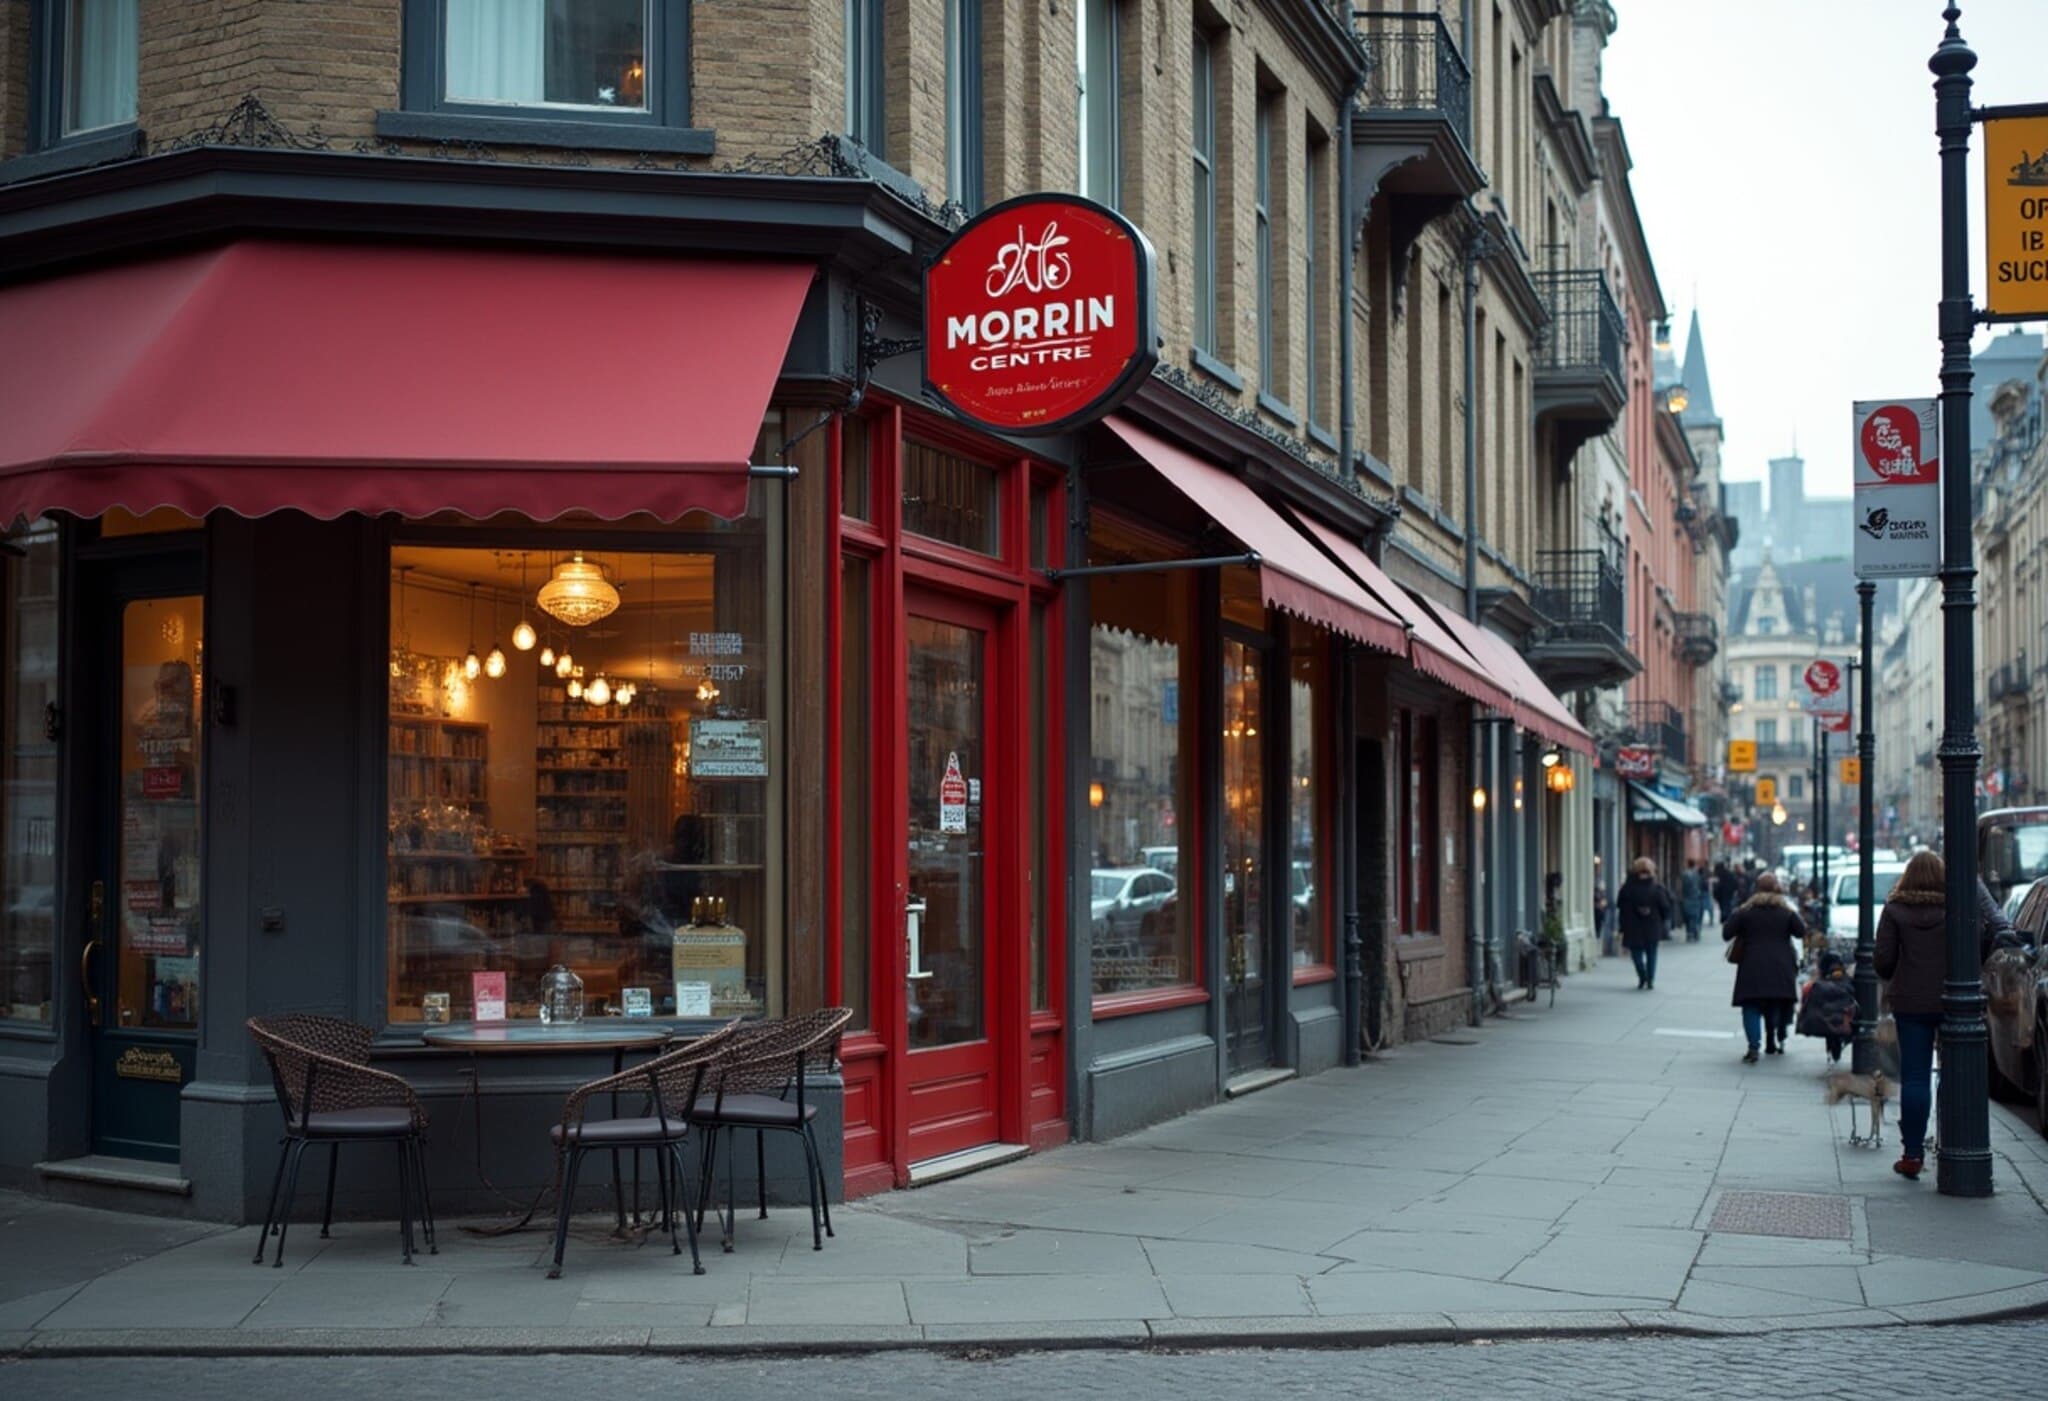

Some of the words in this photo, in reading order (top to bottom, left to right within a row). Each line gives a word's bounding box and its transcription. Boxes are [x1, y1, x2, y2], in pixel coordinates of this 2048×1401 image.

[1998, 260, 2048, 282] SUC
[947, 295, 1114, 349] MORRIN
[970, 345, 1092, 371] CENTRE
